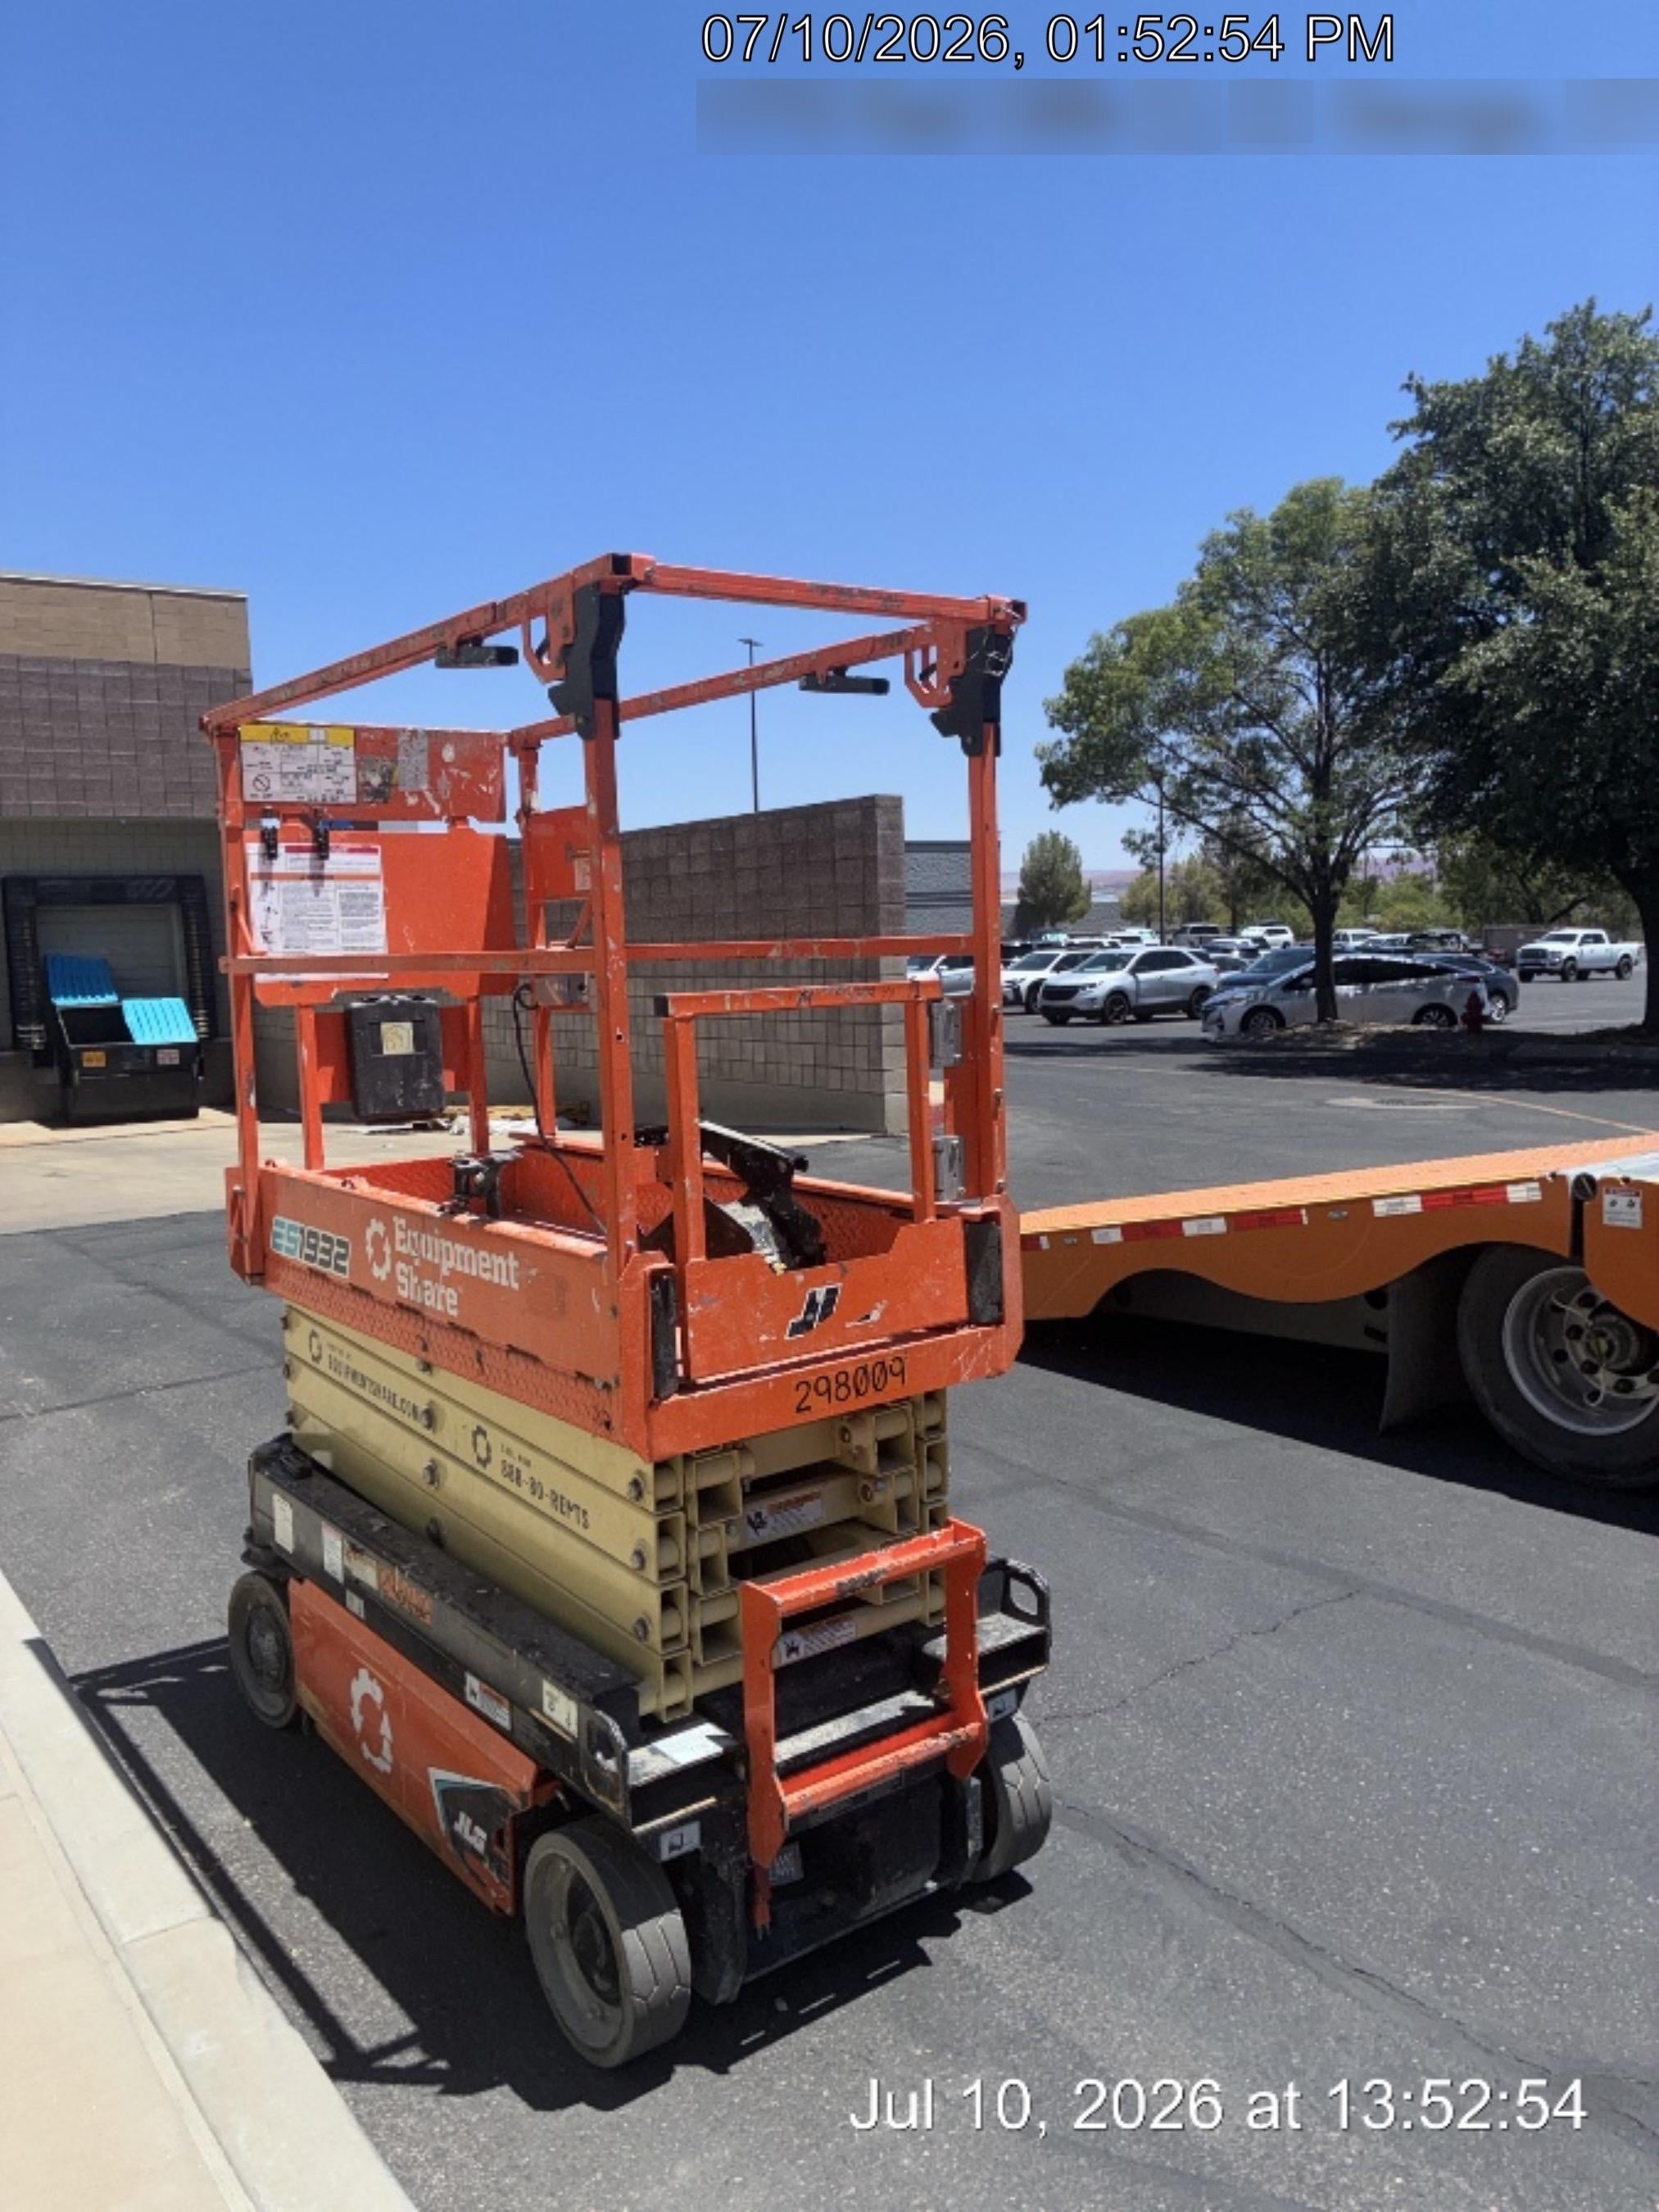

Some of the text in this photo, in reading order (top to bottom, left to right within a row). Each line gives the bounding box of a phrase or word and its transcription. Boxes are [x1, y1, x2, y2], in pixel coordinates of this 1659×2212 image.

[272, 1217, 349, 1276] ES1932
[394, 1216, 519, 1290] Equipment
[396, 1262, 458, 1317] Share
[796, 1356, 905, 1413] 298009
[453, 1810, 487, 1856] JLG
